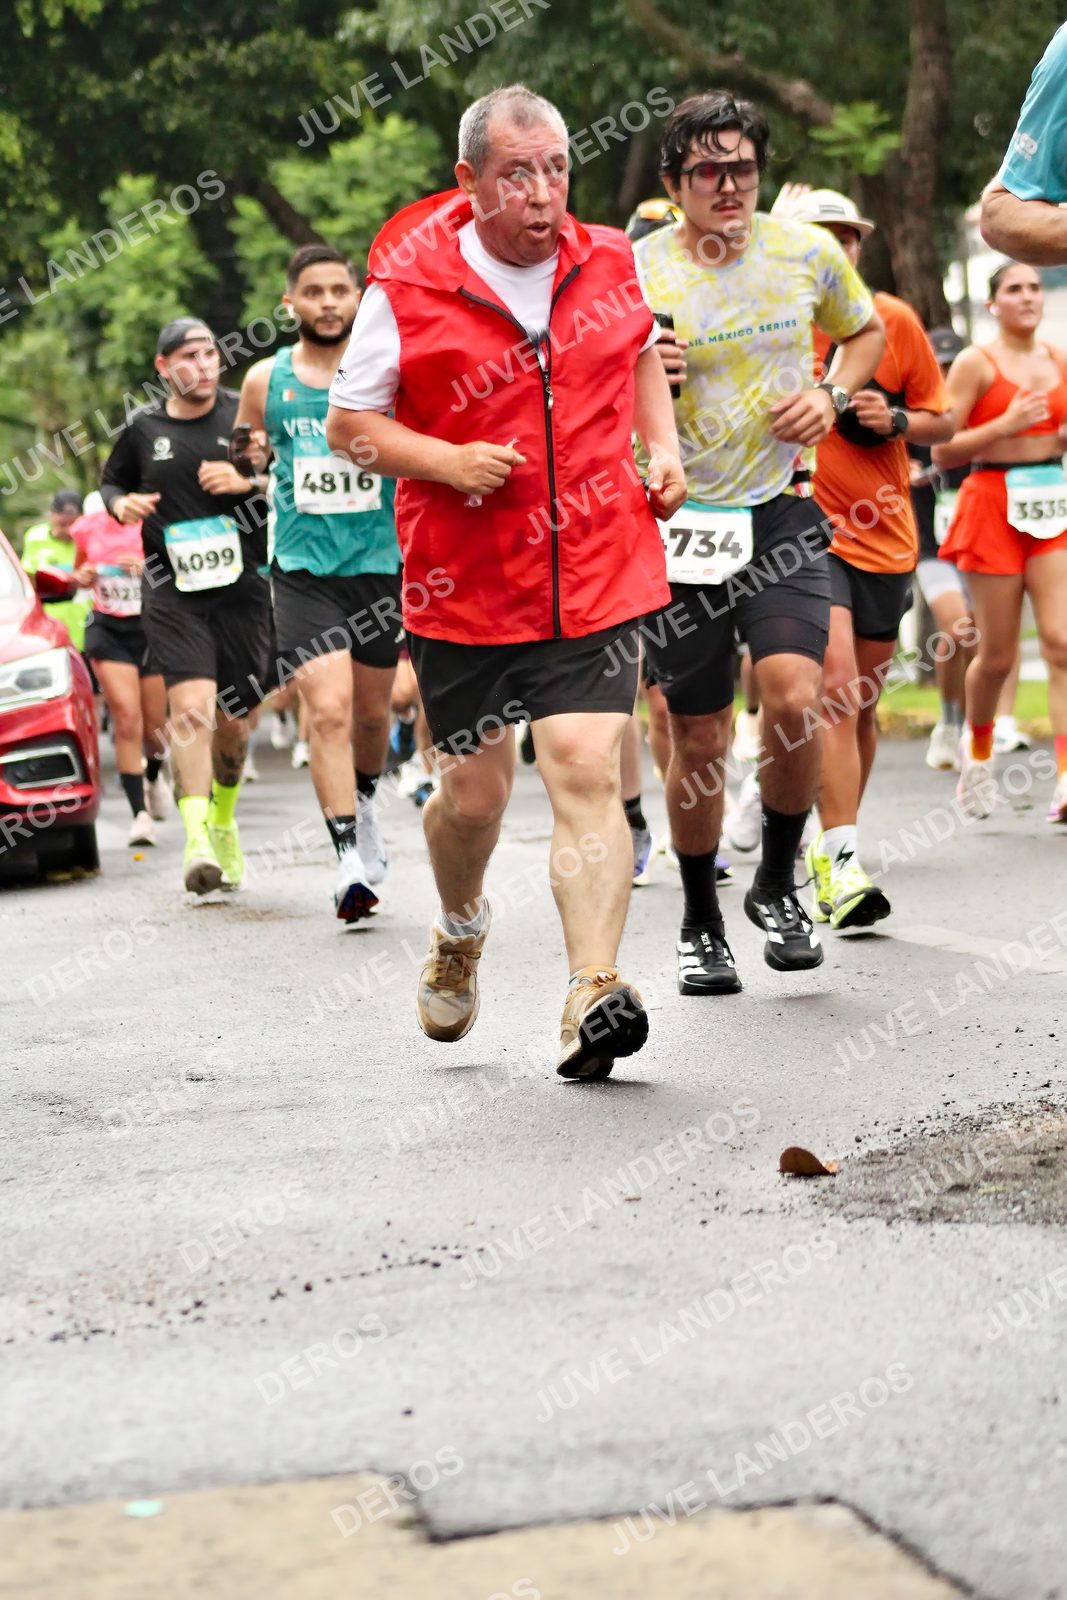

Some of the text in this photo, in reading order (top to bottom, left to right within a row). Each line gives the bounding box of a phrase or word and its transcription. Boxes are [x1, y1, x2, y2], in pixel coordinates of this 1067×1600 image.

[709, 327, 753, 344] MÉXICO
[759, 320, 797, 333] SERIES
[302, 471, 374, 494] 4816
[1015, 499, 1067, 521] 3535
[662, 528, 742, 559] 734
[177, 547, 235, 575] 4099
